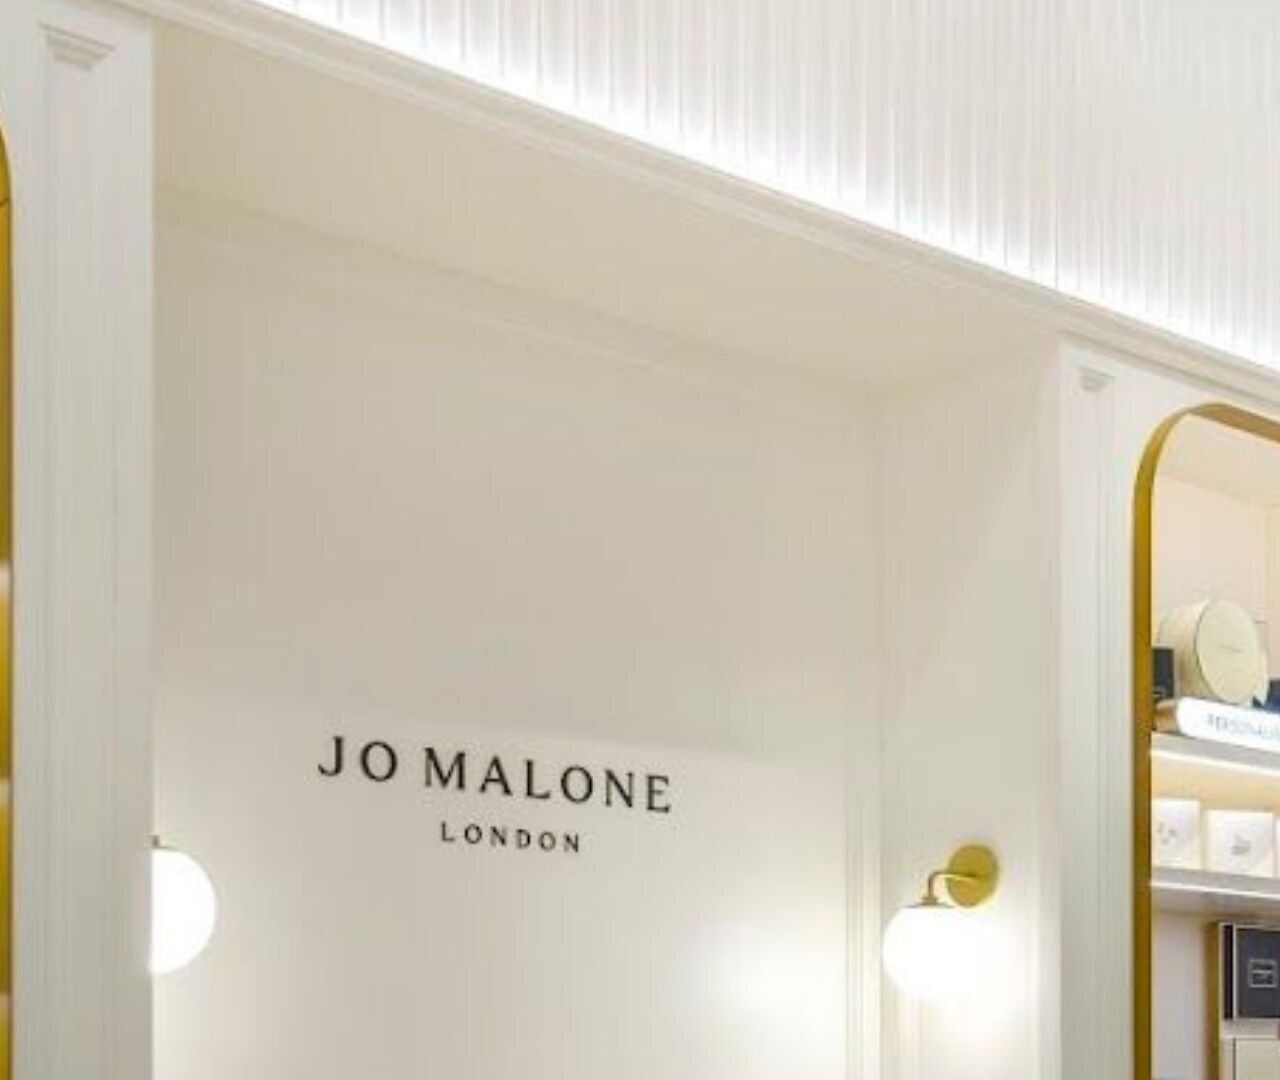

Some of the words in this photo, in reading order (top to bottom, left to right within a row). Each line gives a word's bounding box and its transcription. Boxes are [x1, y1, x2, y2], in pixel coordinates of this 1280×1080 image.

[317, 734, 398, 783] JO
[422, 746, 672, 814] MALONE
[440, 820, 581, 853] LONDON
